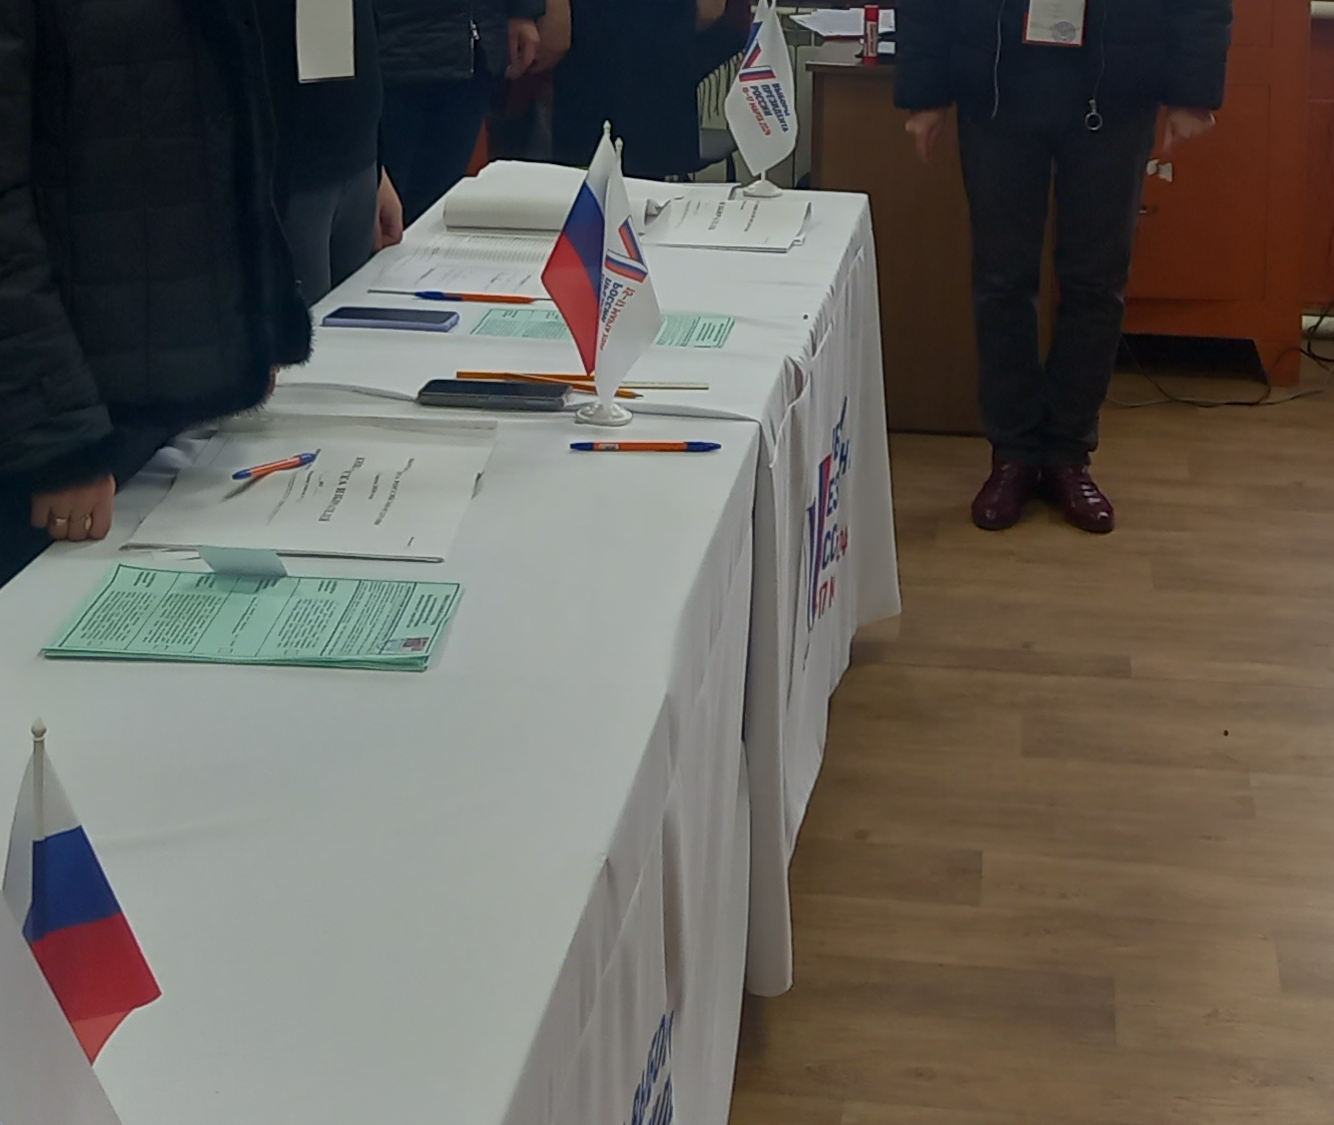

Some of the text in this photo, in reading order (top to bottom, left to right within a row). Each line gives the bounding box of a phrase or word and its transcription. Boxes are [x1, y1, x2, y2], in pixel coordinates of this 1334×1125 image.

[750, 85, 773, 117] РОССИИ
[761, 84, 789, 133] ПРЕЗИДЕНТА
[772, 82, 790, 117] ВЫБОРЫ
